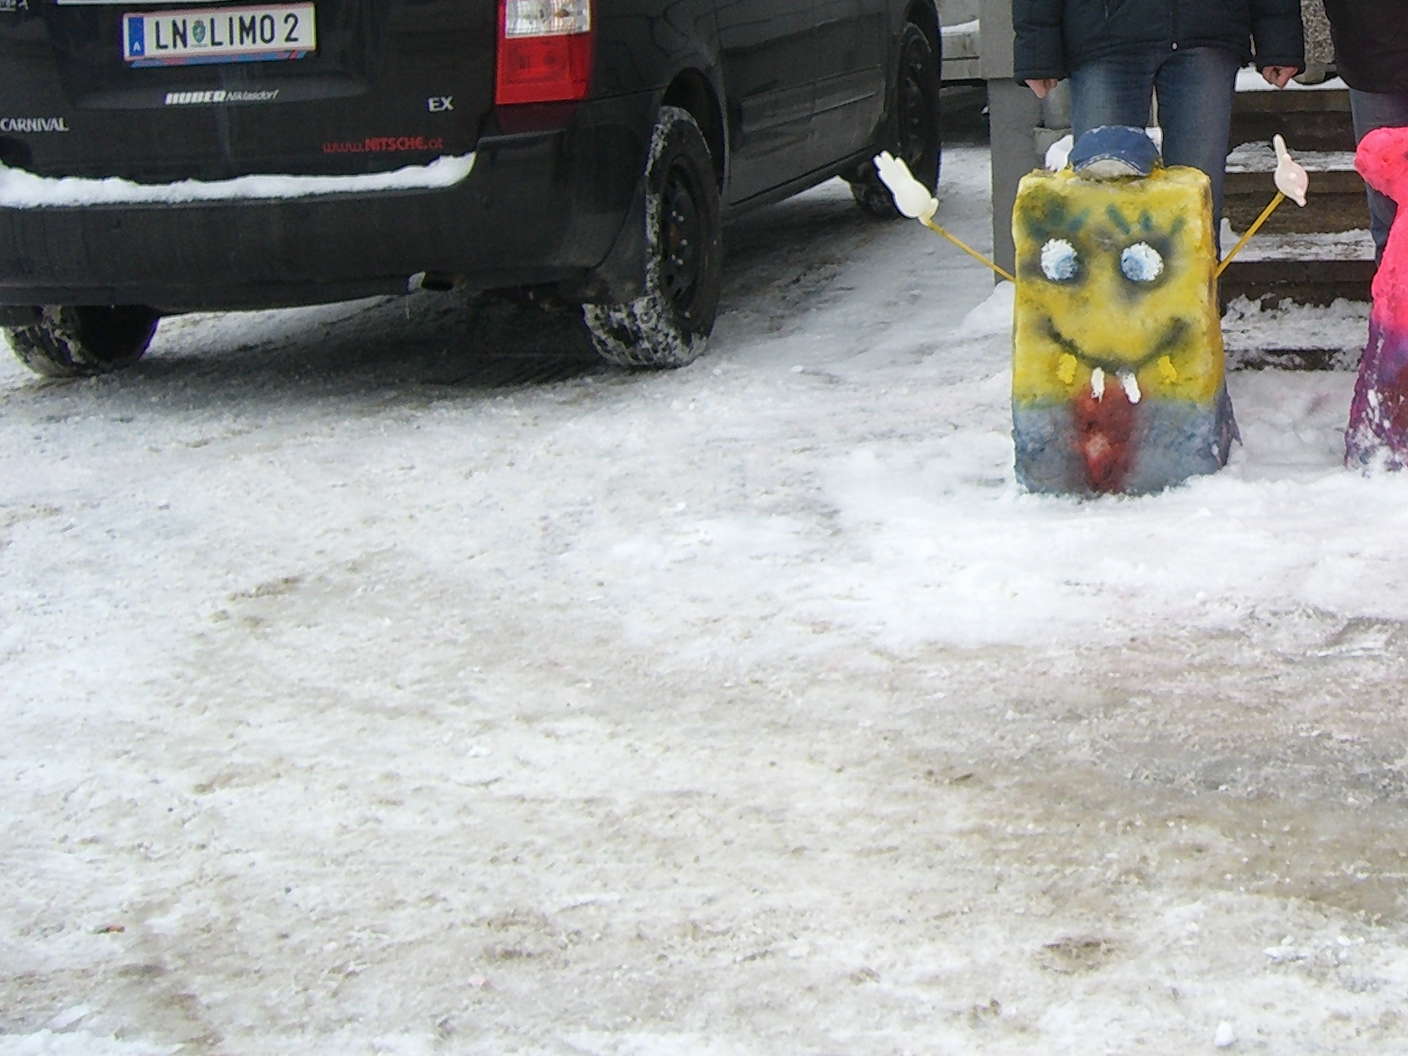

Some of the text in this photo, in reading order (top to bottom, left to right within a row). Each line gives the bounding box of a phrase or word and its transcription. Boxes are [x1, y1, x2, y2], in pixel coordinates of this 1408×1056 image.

[154, 13, 300, 50] LN LIMO 2
[164, 90, 226, 105] HUBER
[428, 96, 454, 112] EX
[0, 117, 69, 133] CARNIVAL
